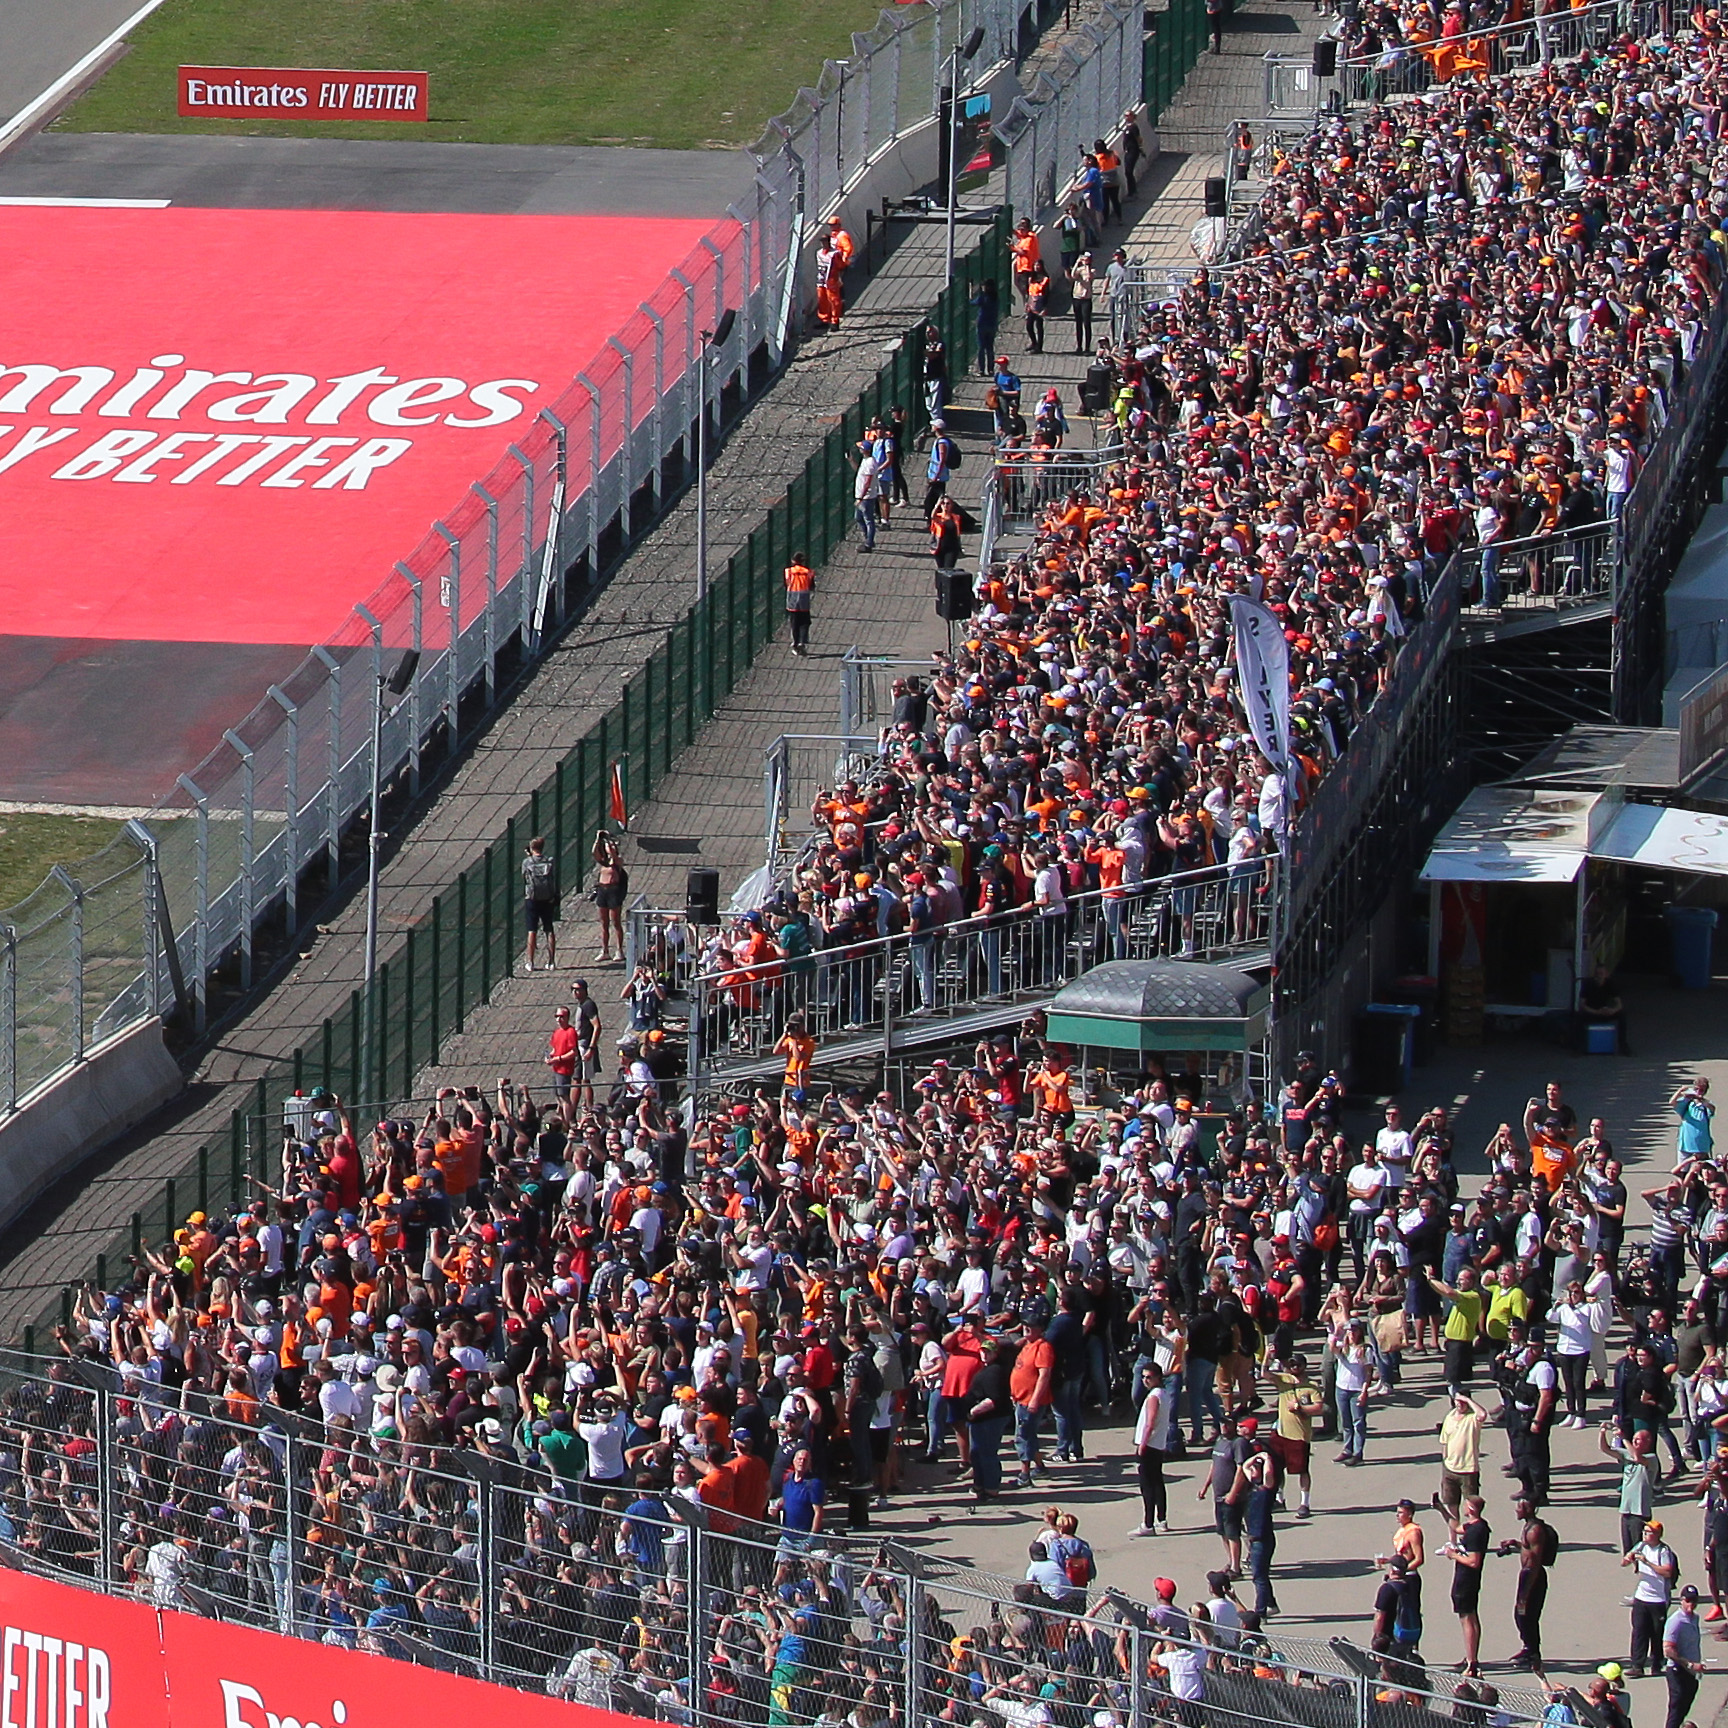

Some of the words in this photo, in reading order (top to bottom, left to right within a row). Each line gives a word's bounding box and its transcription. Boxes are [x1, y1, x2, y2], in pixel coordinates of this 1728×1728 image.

[187, 79, 307, 108] Emirates
[318, 83, 349, 109] FLY
[352, 83, 417, 110] BETTER
[51, 428, 414, 490] BETTER
